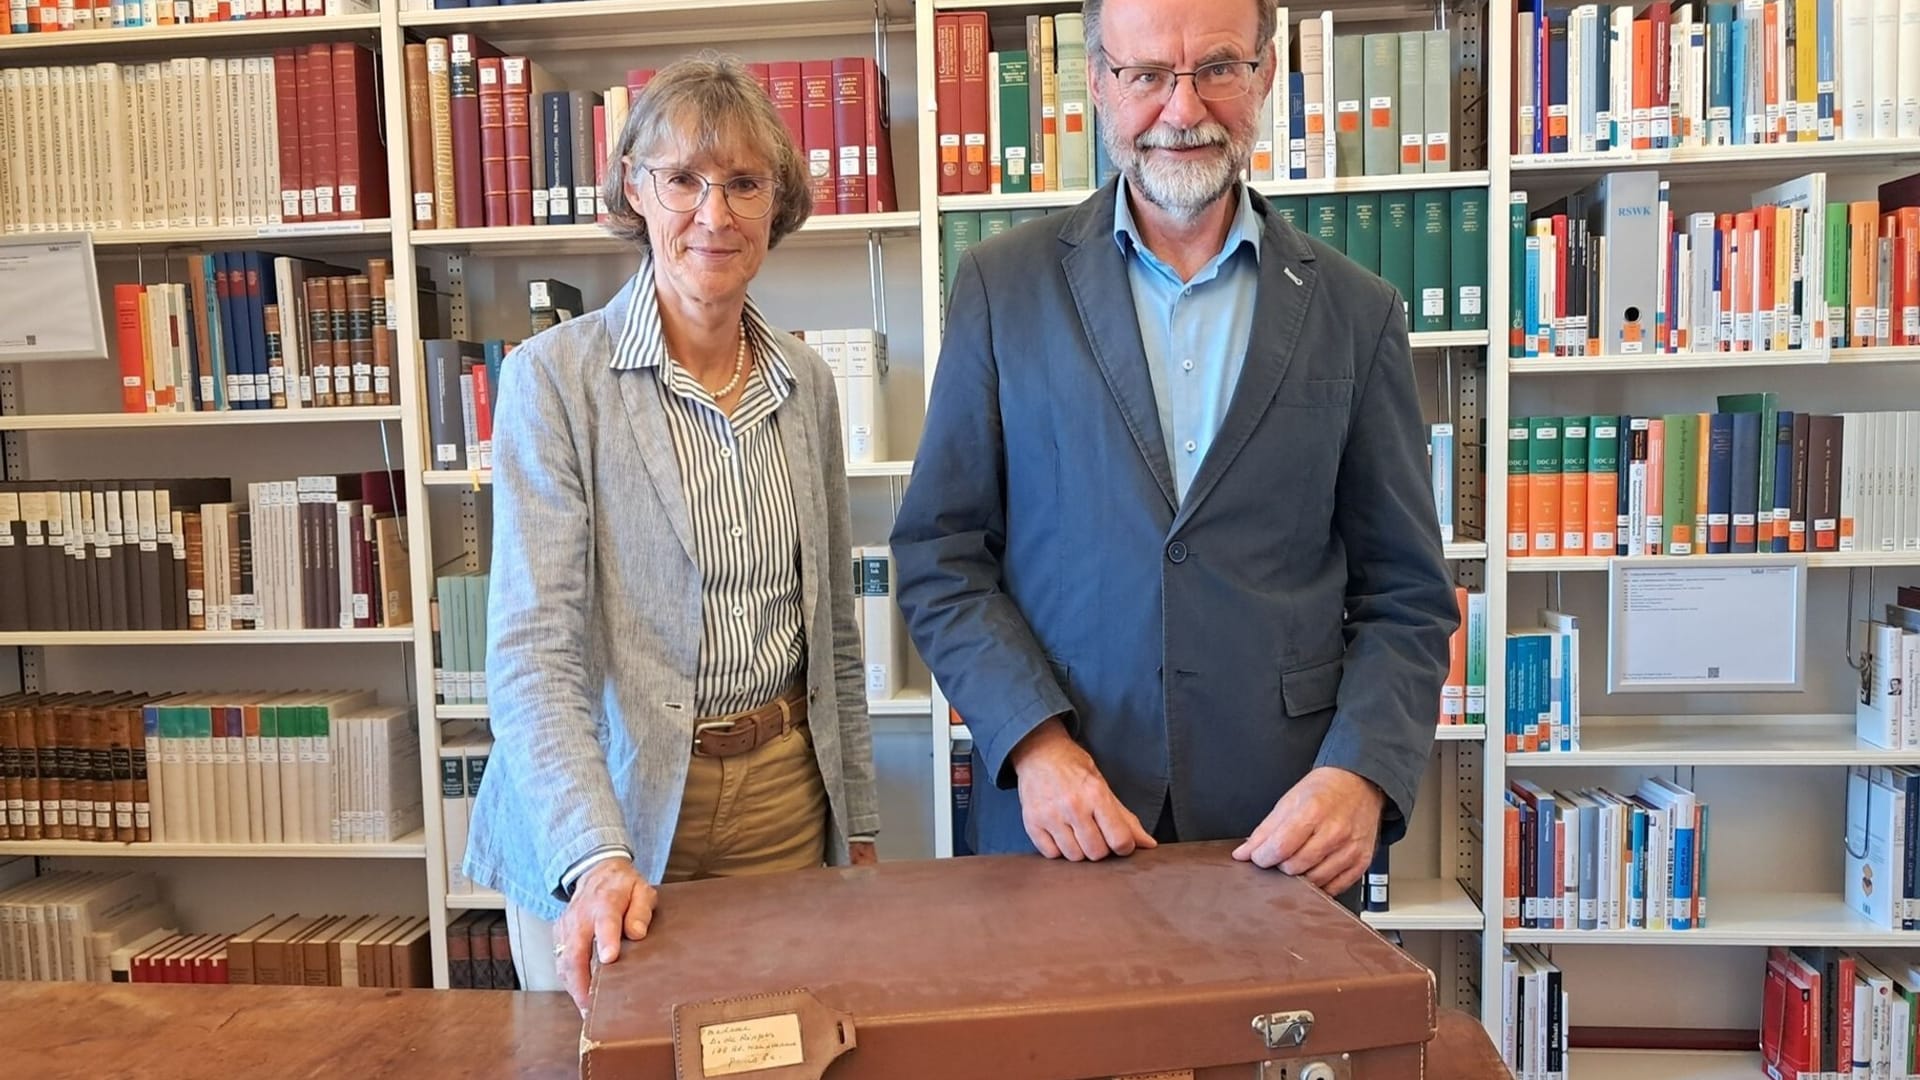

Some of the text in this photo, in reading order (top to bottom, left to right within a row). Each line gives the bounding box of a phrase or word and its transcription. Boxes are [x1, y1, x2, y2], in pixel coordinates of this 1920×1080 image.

[1618, 206, 1651, 217] RSWK
[1793, 208, 1802, 274] Langzeitarchivierung
[1840, 1027, 1851, 1047] Read
